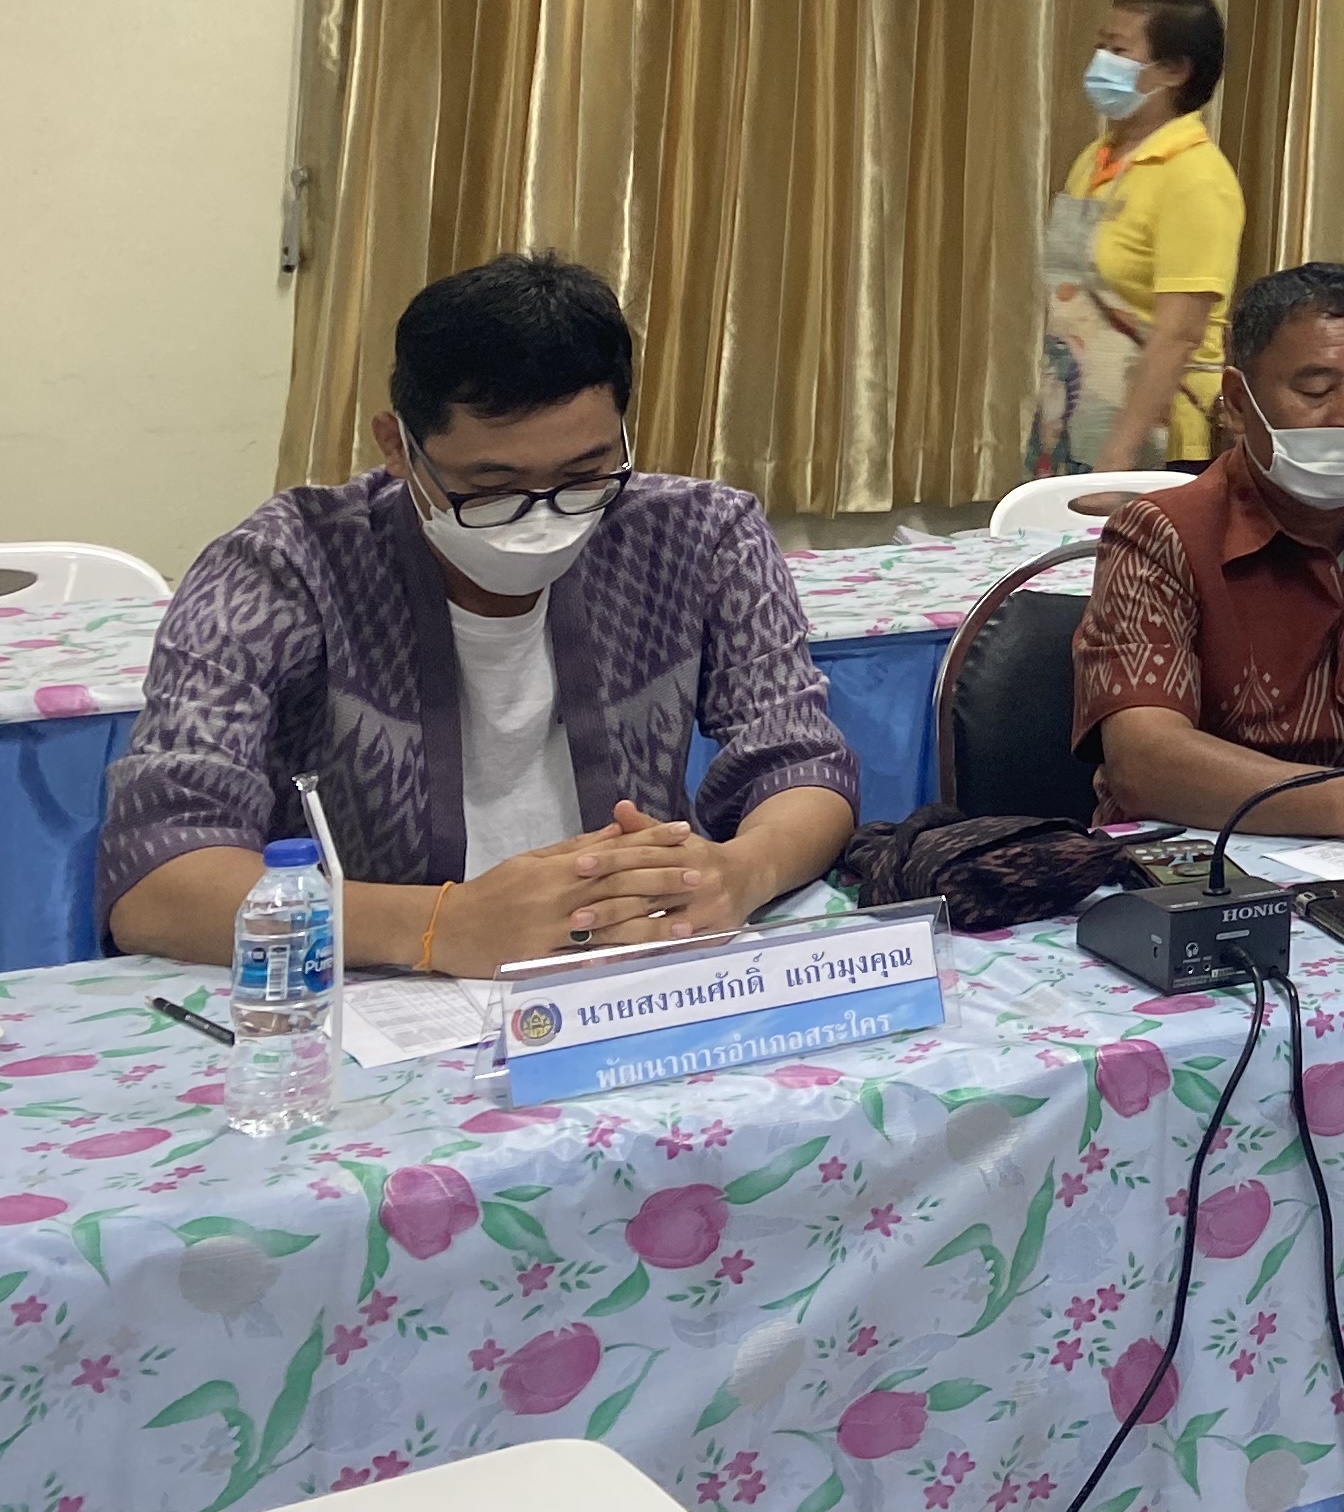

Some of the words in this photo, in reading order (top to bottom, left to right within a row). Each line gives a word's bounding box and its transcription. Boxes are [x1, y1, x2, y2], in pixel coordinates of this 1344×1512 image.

[577, 952, 767, 1027] นายสงวนศักดิ์
[785, 944, 913, 989] แก้วมุงคุณ
[595, 1009, 891, 1090] พัฒนาการอำเภอสระใคร
